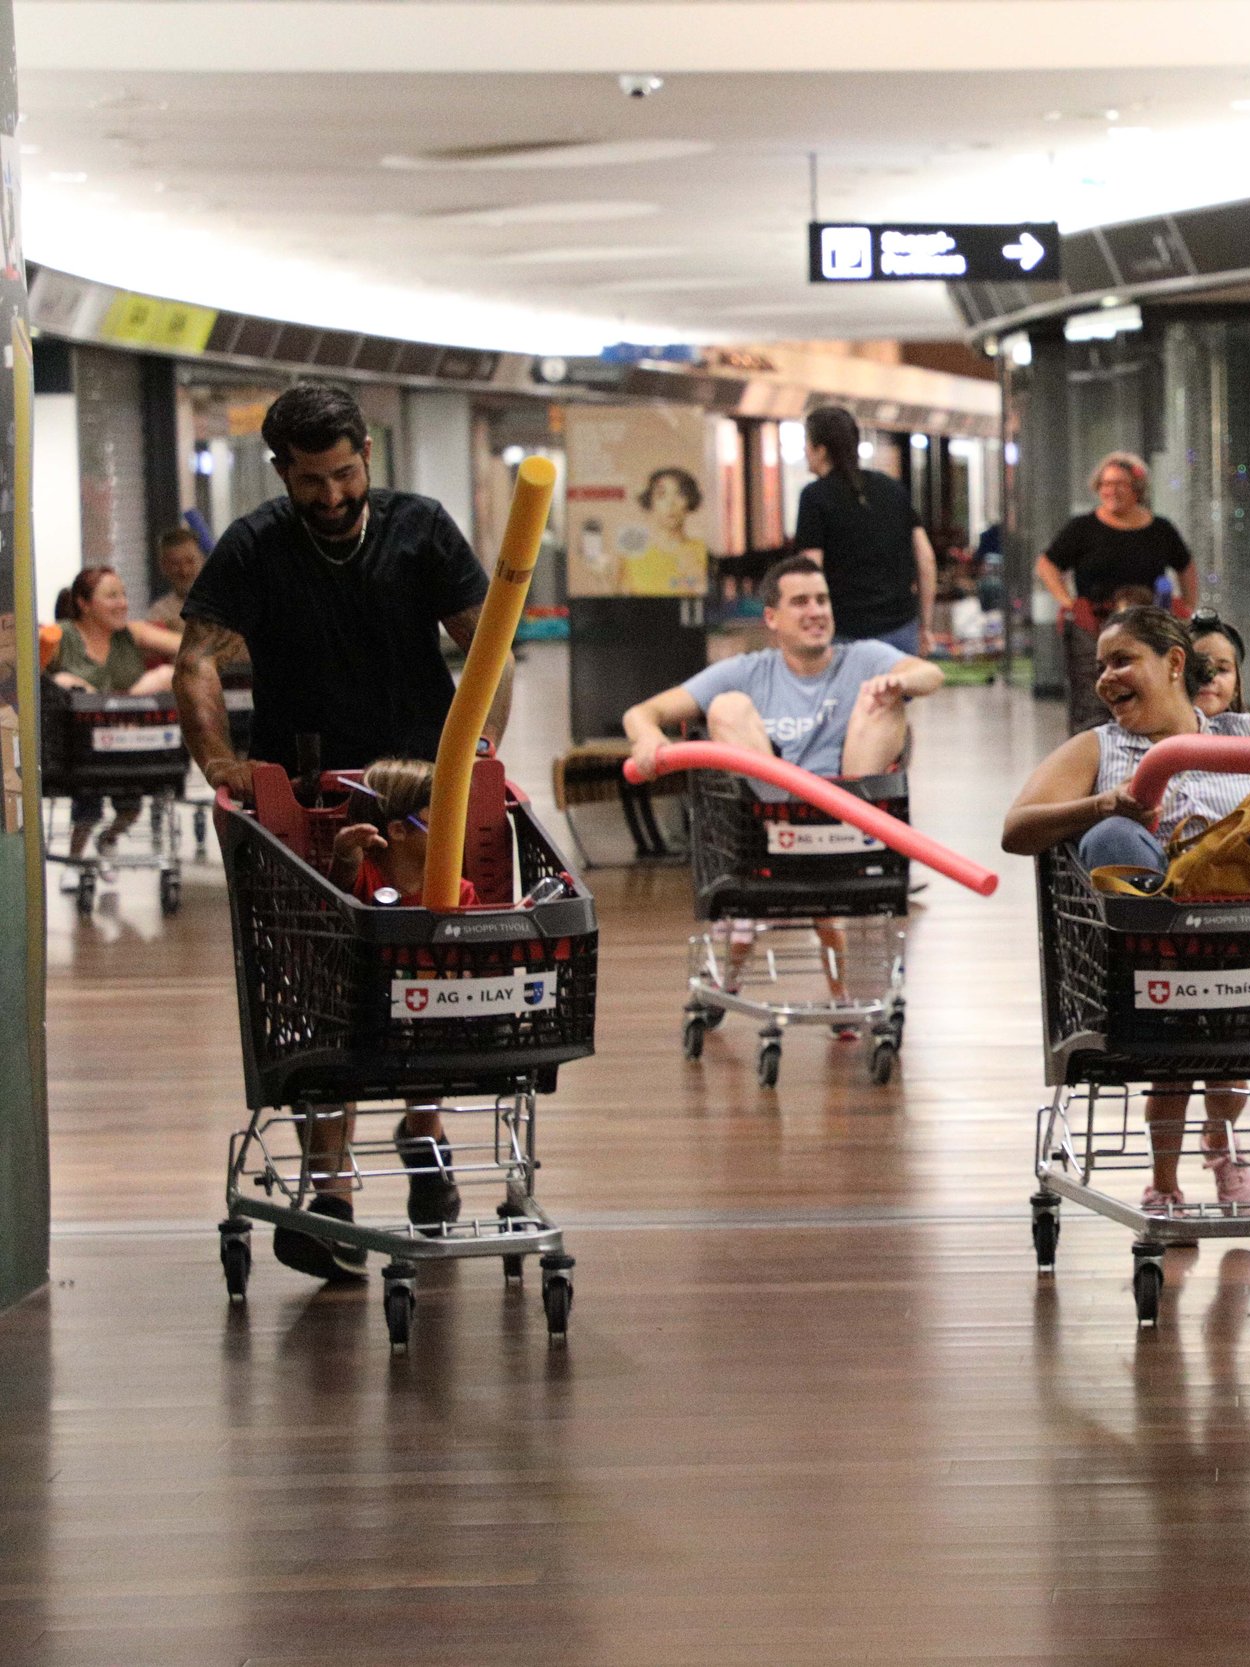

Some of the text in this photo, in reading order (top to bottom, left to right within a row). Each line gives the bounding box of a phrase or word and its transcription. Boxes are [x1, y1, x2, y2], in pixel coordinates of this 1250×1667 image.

[762, 698, 839, 742] ESPT
[436, 987, 514, 1004] AG ILAY
[1175, 985, 1197, 997] AG
